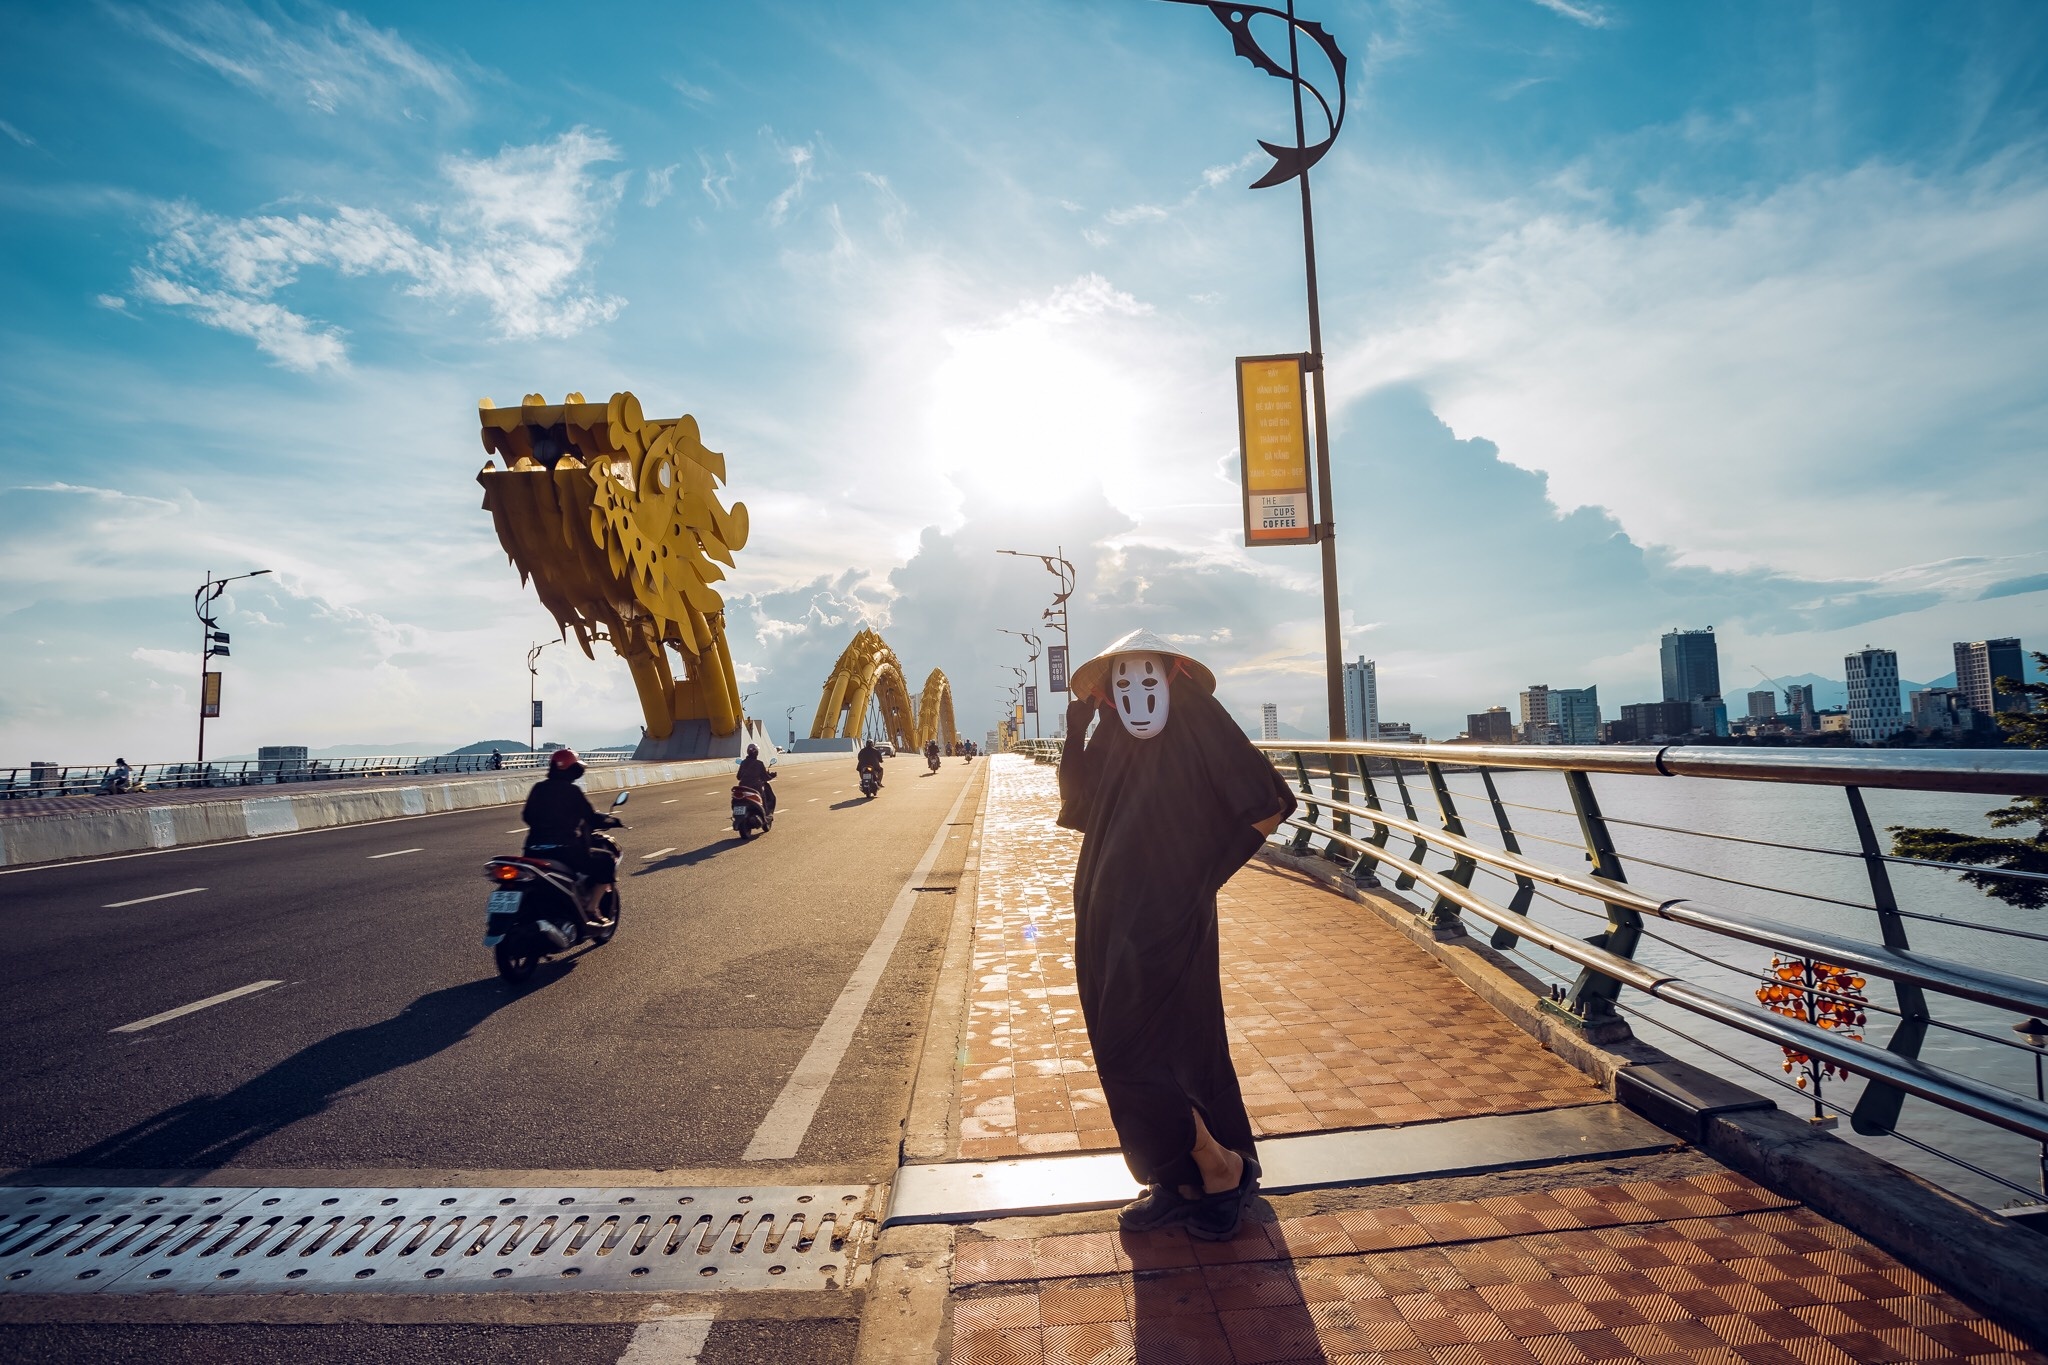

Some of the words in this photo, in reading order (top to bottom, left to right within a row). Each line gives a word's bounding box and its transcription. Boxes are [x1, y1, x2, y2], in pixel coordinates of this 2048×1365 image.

[1262, 497, 1276, 505] THE
[1274, 508, 1295, 516] CUPS
[1263, 519, 1296, 528] COFFEE
